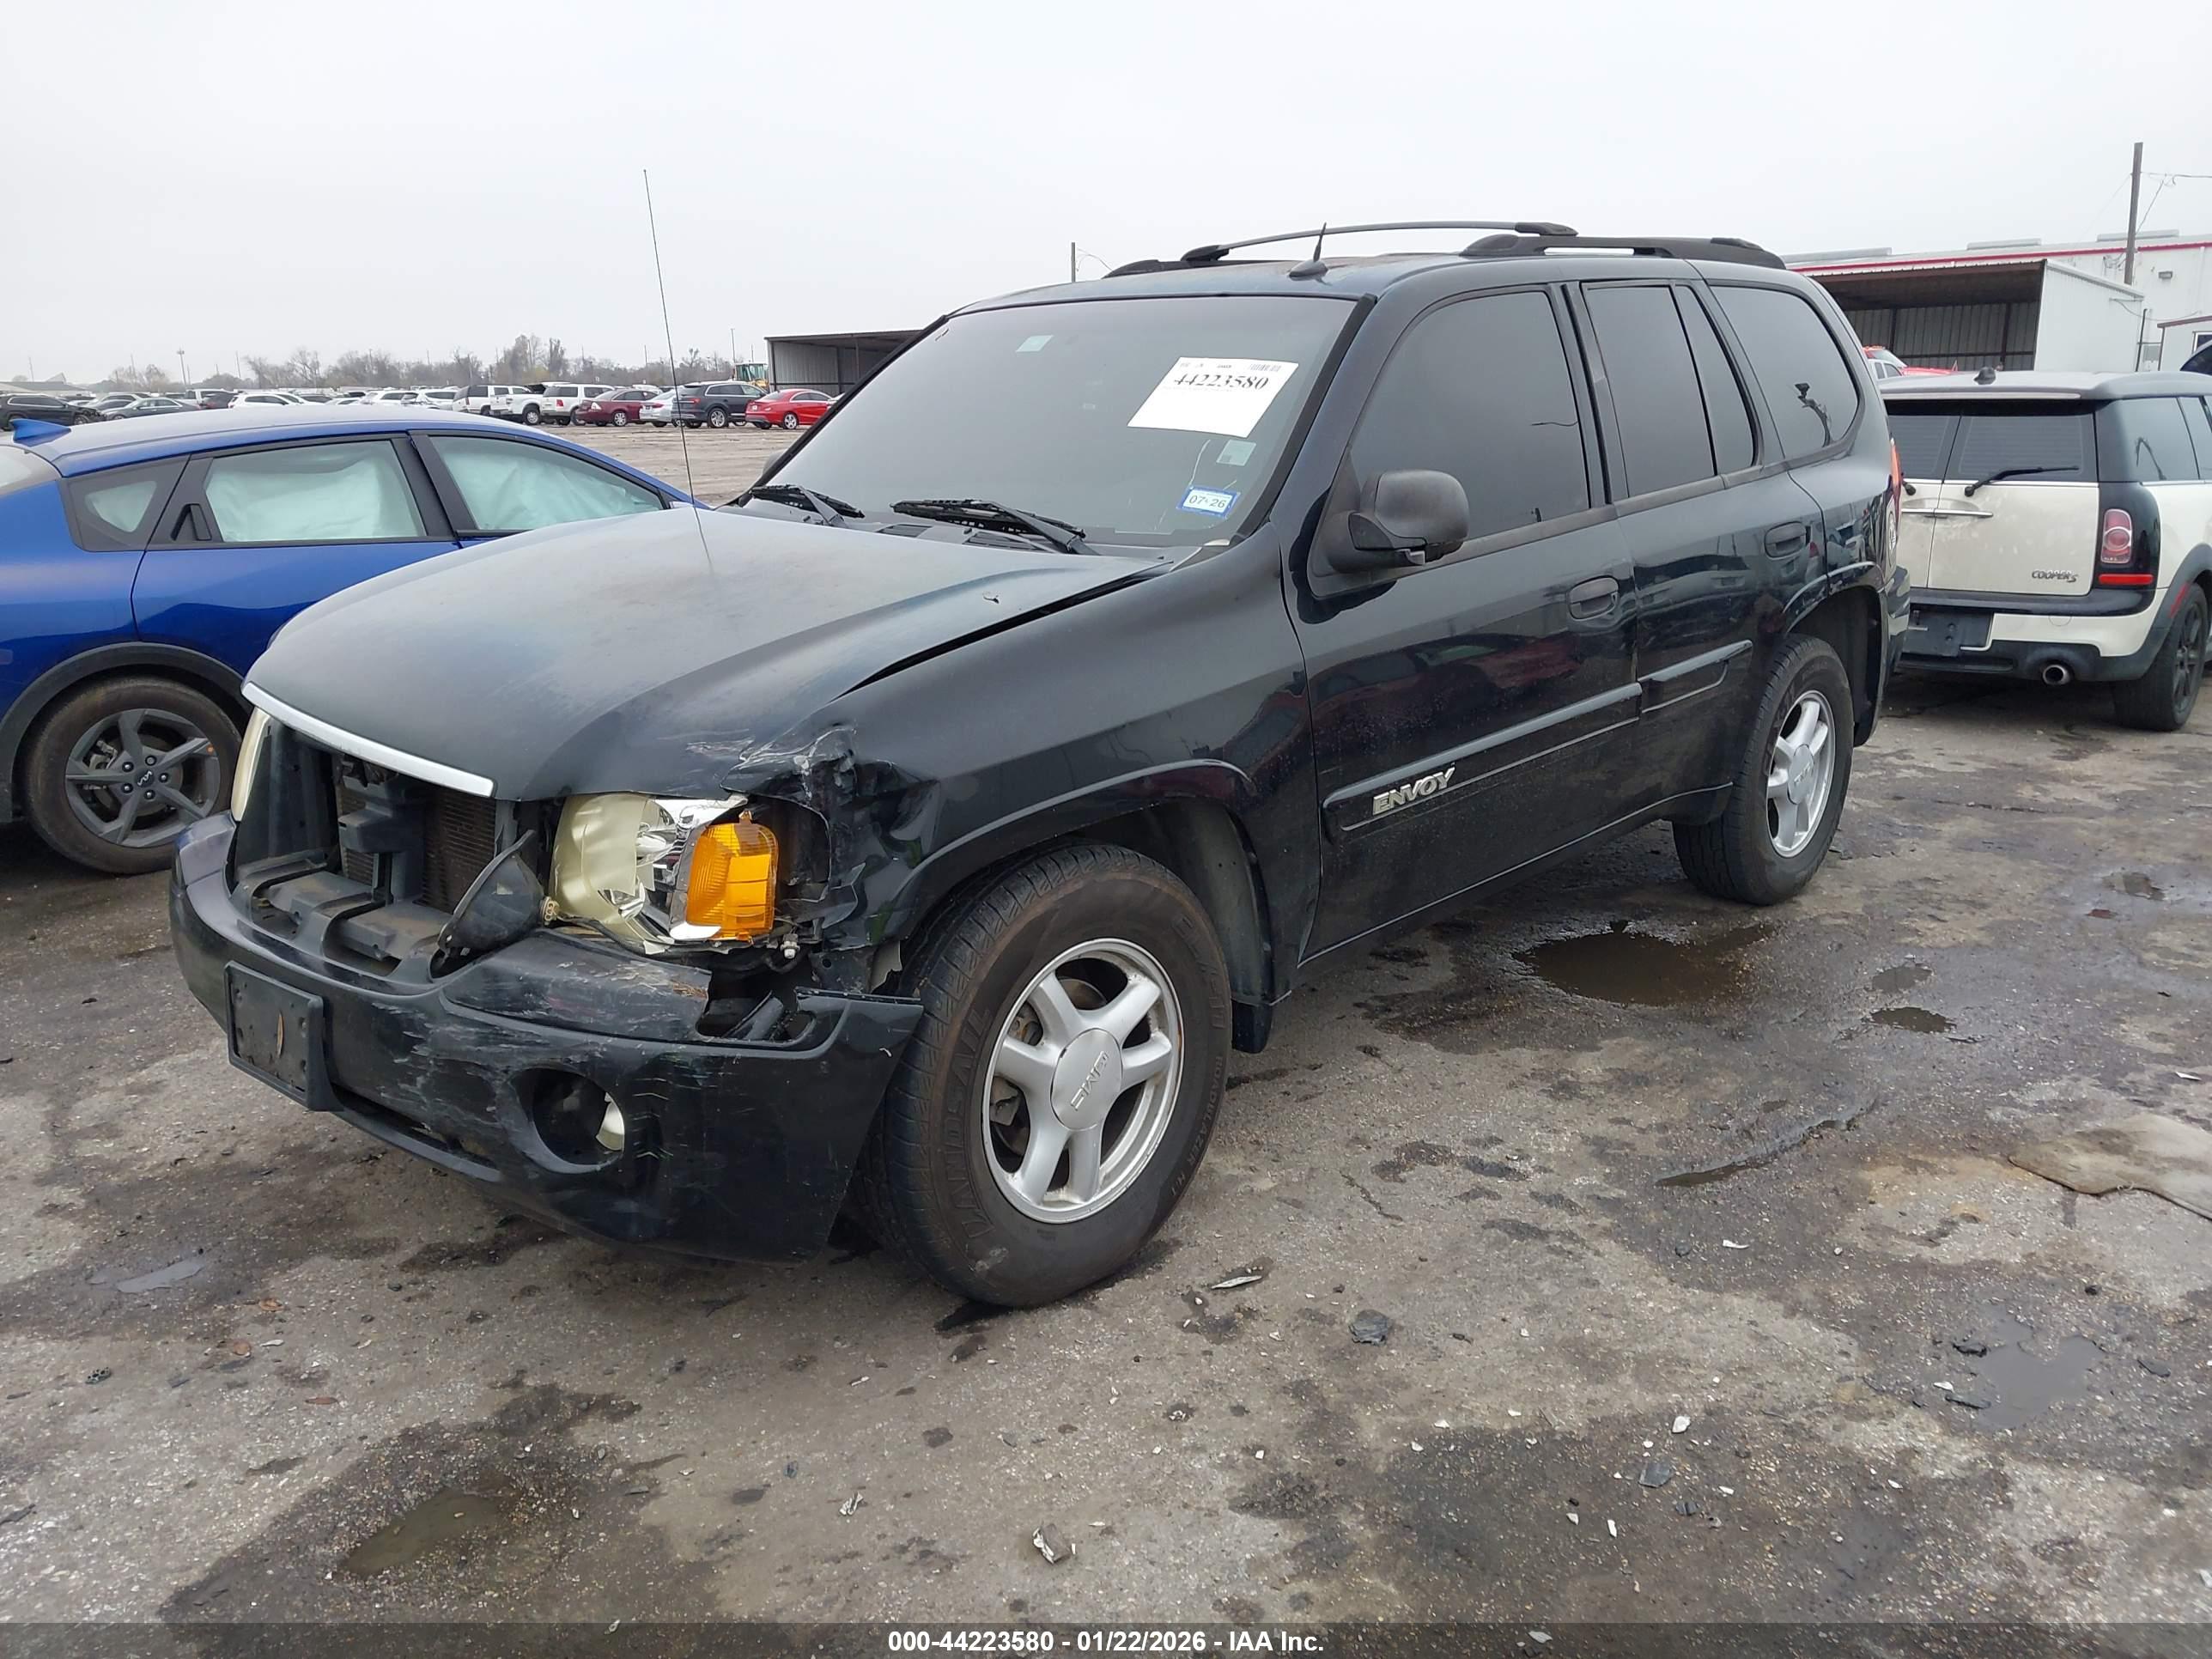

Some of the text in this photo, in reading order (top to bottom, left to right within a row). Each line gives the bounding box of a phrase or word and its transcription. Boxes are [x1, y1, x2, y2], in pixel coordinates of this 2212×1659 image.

[1174, 374, 1269, 390] 44223580
[1373, 767, 1455, 816] ENVOY
[1070, 1049, 1110, 1113] GMC
[942, 1007, 996, 1239] LANDSAIL
